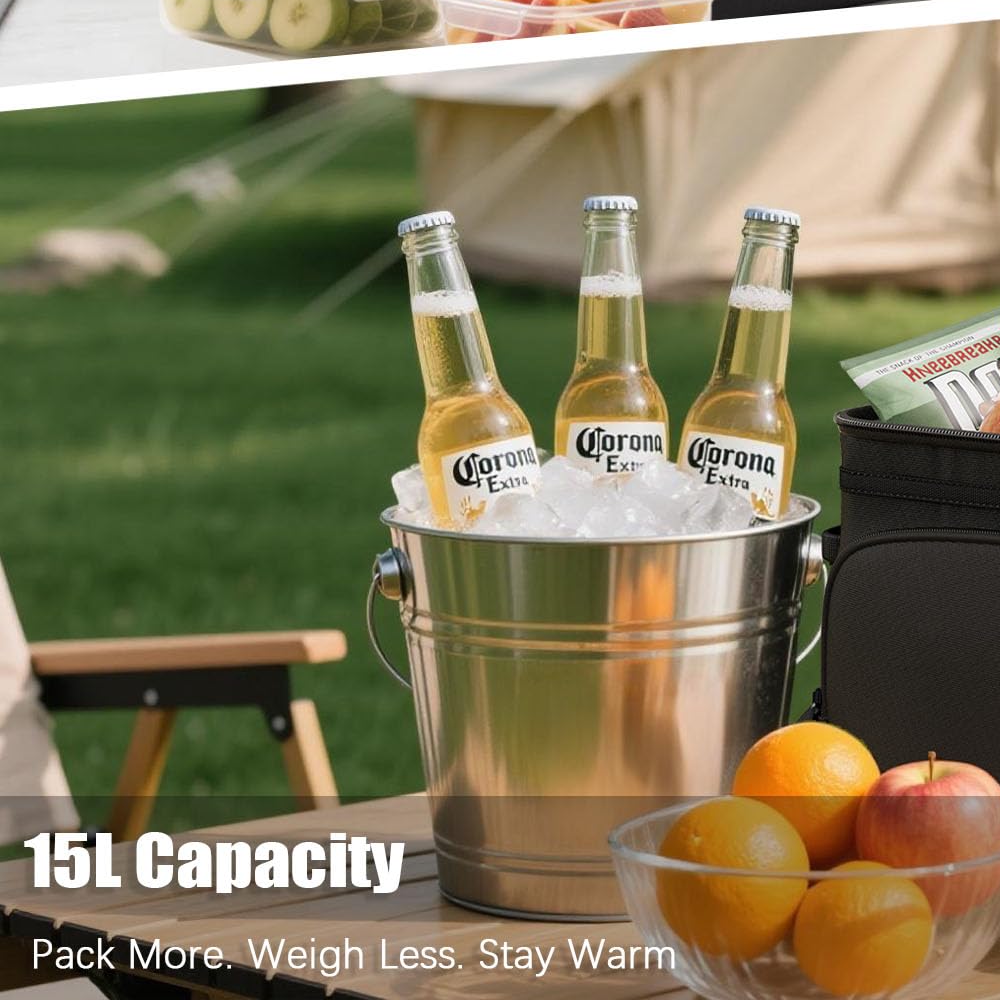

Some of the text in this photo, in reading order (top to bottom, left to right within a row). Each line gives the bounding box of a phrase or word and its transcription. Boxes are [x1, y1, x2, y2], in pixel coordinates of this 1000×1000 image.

[576, 426, 663, 463] Corona
[688, 437, 776, 477] Corona
[453, 447, 536, 488] Corona
[487, 475, 528, 493] Extra
[705, 467, 750, 490] Extra
